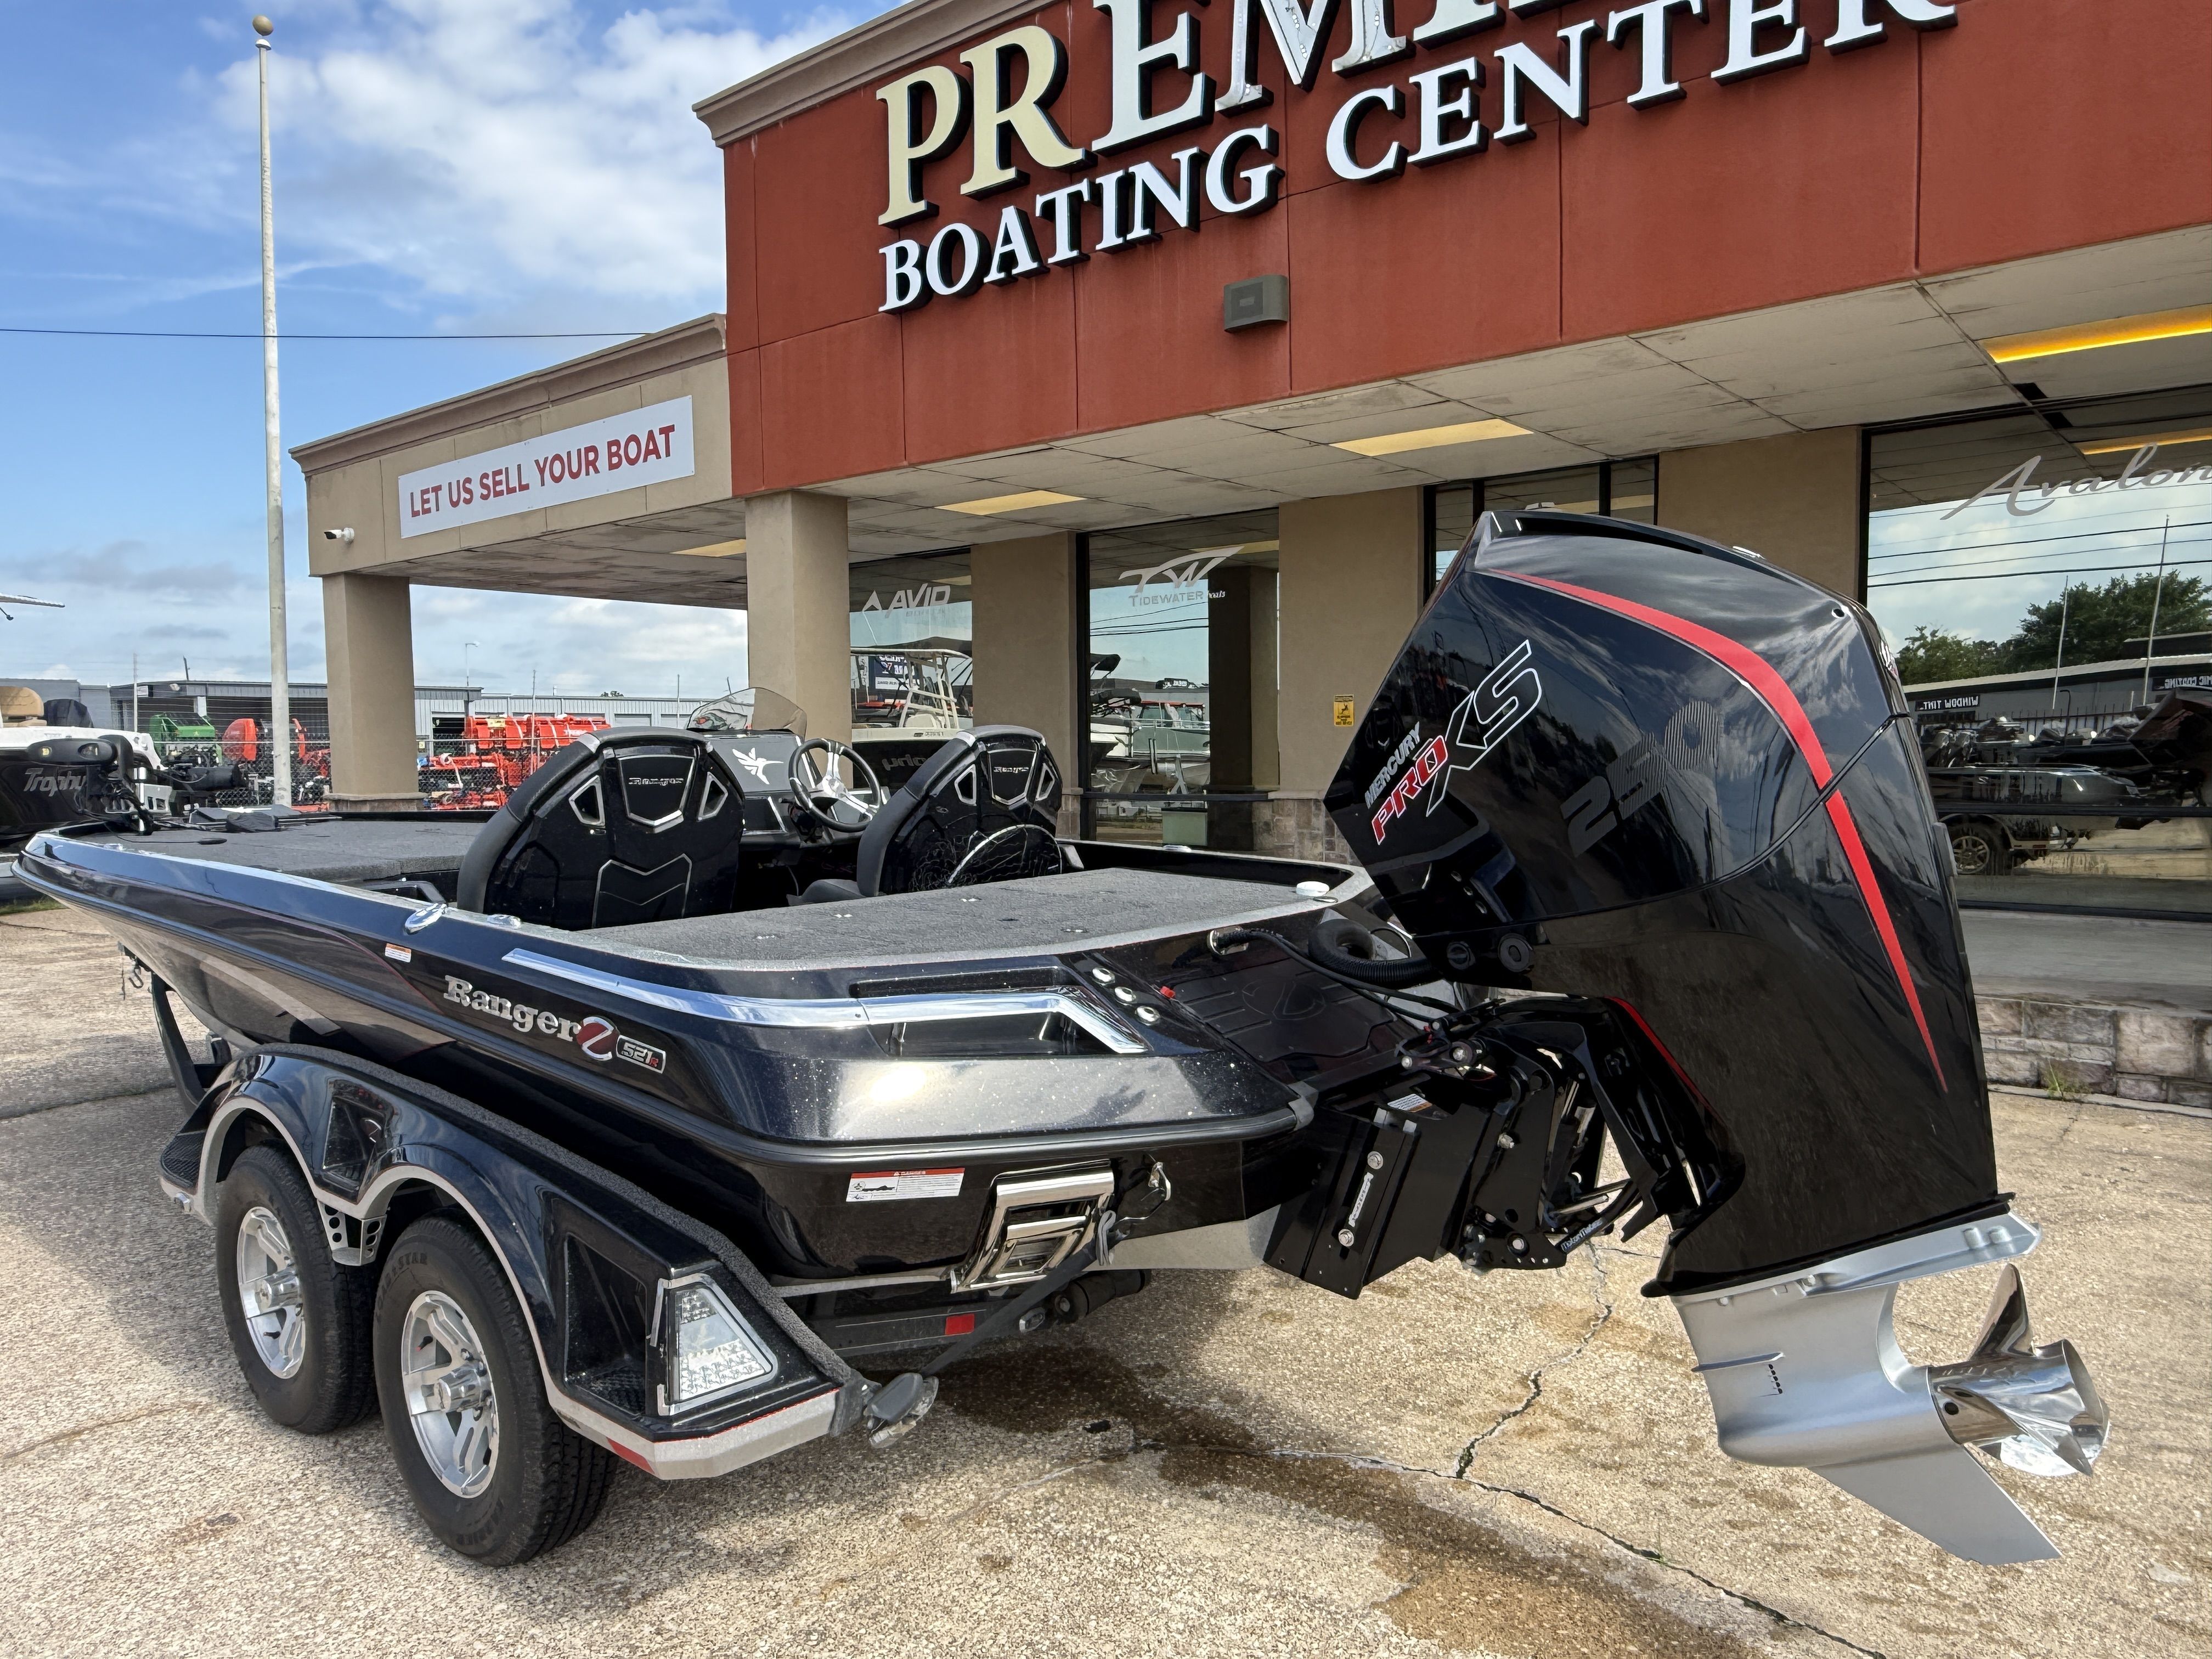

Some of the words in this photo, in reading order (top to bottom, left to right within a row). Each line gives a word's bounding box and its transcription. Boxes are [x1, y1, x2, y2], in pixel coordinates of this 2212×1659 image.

[878, 124, 1276, 312] BOATING
[410, 486, 442, 517] LET
[448, 476, 474, 508] US
[479, 464, 530, 501] SELL
[534, 445, 600, 487] YOUR
[606, 424, 675, 471] BOAT
[1940, 442, 2212, 521] Avalon
[885, 583, 951, 619] AVID
[1128, 590, 1204, 607] TIDEWATER
[1364, 721, 1420, 810] MERCURY
[1372, 735, 1448, 845] PRO
[1560, 701, 1719, 859] 250
[443, 974, 582, 1043] Ranger
